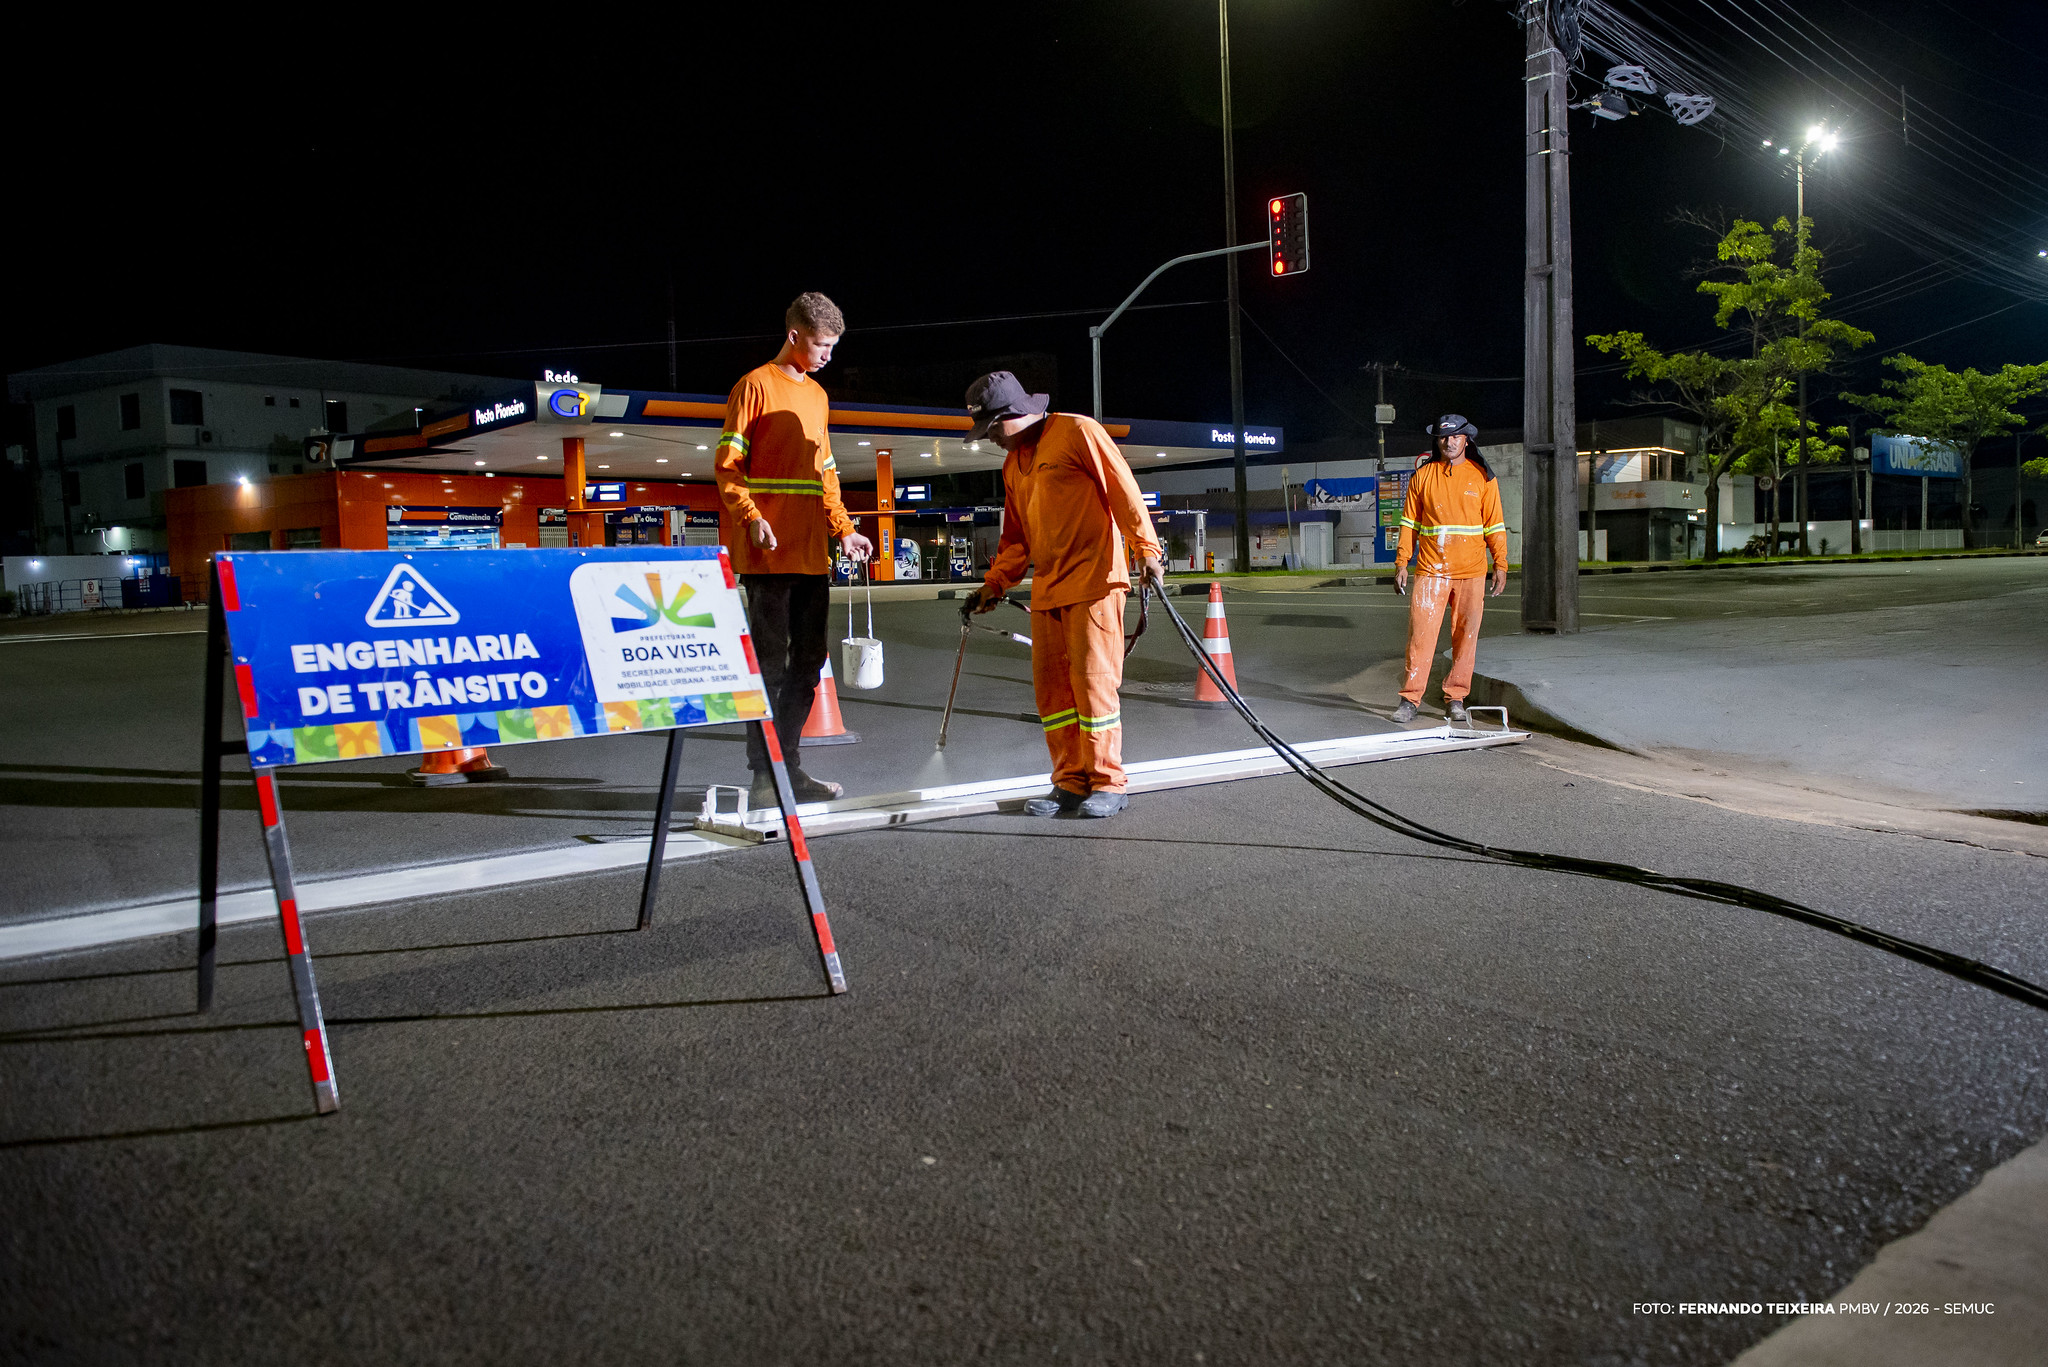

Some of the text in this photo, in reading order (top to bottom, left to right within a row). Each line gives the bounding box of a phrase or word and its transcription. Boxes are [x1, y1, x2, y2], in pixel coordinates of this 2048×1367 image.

[545, 370, 579, 384] Rede
[475, 399, 525, 425] Posto Pioneiro
[1243, 431, 1276, 445] ioneiro
[449, 512, 491, 521] Conveniência
[291, 633, 541, 673] ENGENHARIA
[622, 643, 721, 662] BOA VISTA
[621, 668, 673, 678] SECRETARIA
[674, 665, 717, 674] MUNICIPAL
[617, 679, 669, 689] MOBILIDADE
[671, 677, 705, 685] URBANA
[710, 674, 739, 682] SEMOB
[298, 671, 549, 716] DE TRÂNSITO
